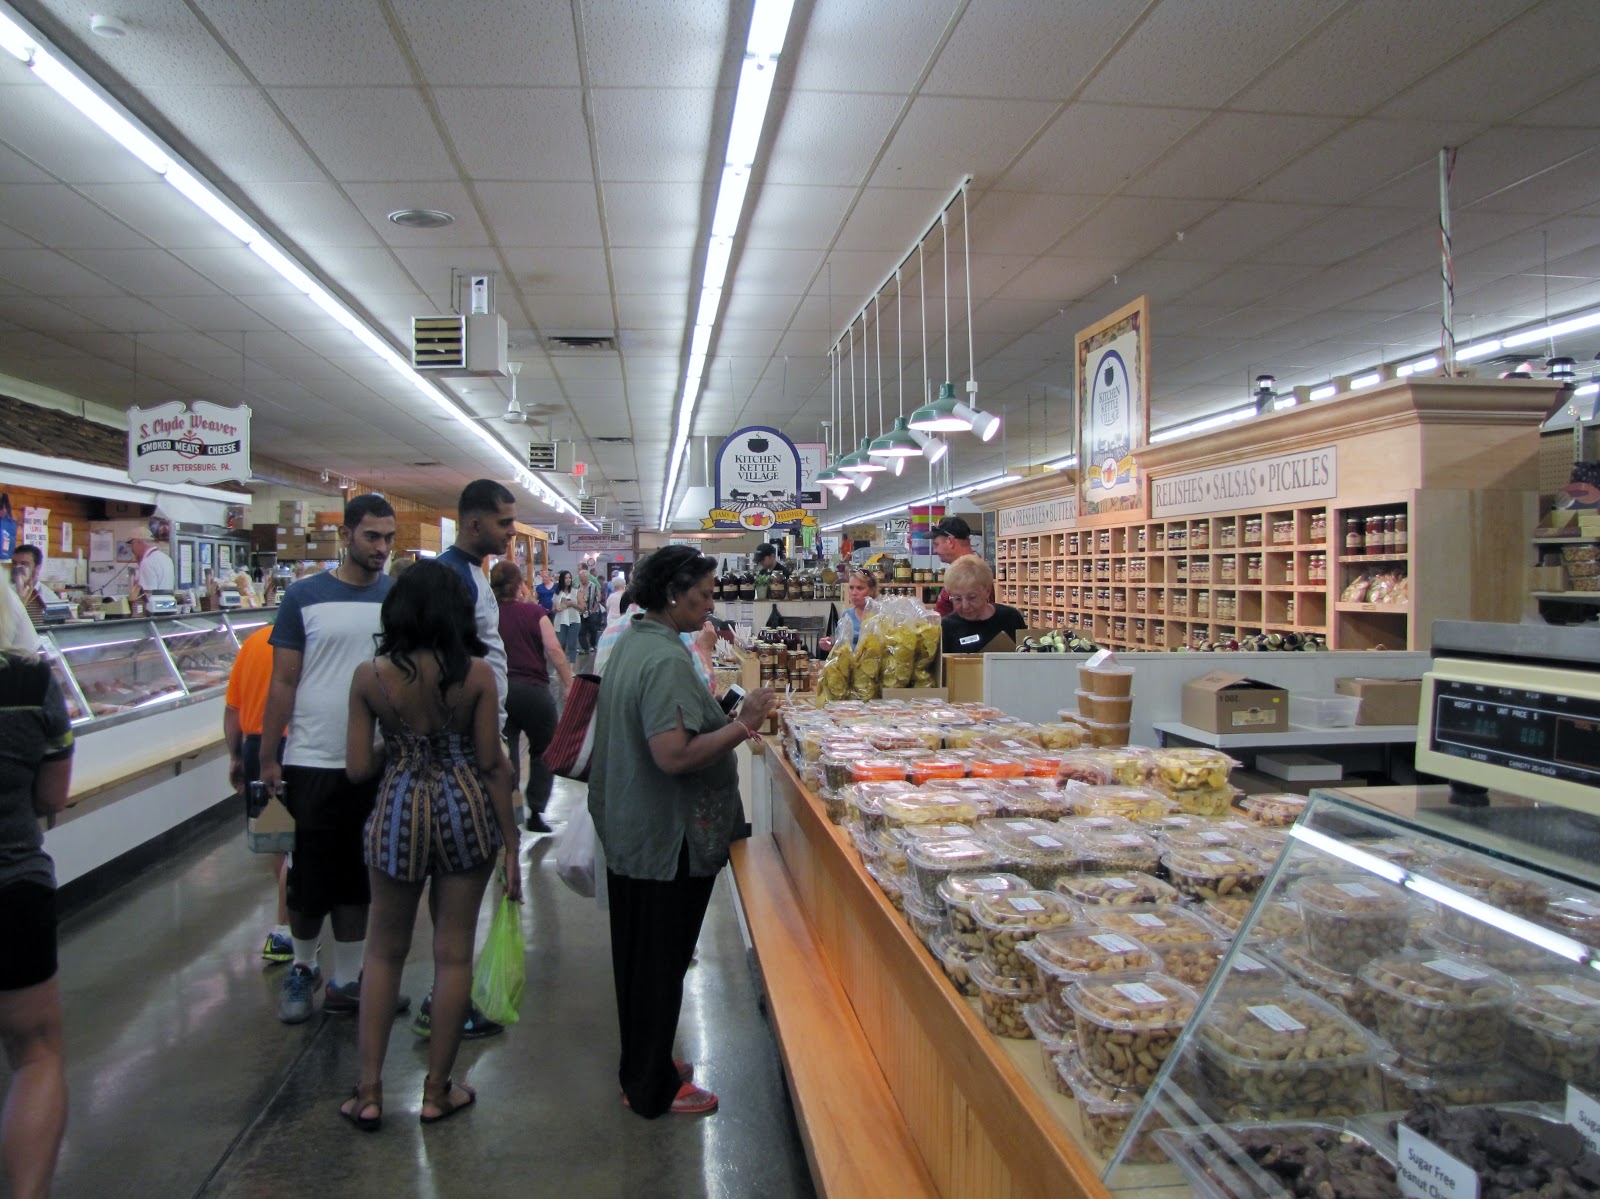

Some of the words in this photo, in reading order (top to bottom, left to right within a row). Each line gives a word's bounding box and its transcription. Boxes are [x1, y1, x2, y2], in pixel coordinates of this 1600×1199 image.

[1099, 385, 1121, 404] KITCHEN
[1101, 398, 1119, 413] KETTLE
[1101, 409, 1119, 424] VILLAGE
[153, 416, 185, 436] Clyde
[190, 415, 237, 436] Weaver
[142, 441, 172, 454] SMOKED
[175, 442, 200, 454] MEATS
[208, 443, 237, 455] CHEESE
[735, 455, 781, 464] KITCHEN
[150, 464, 169, 472] EAST
[738, 472, 780, 480] VILLAGE
[1156, 477, 1203, 507] RELISHES
[1213, 467, 1256, 500] SALSAS
[1268, 454, 1328, 492] PICKLES
[715, 510, 730, 518] JAMS
[777, 509, 803, 519] RELISHES
[1000, 511, 1012, 534] JAMS
[1016, 505, 1045, 527] PRESERVES
[1454, 701, 1471, 709] WEIGHT
[1512, 710, 1527, 719] PRICE
[1509, 760, 1530, 769] CAPACITY
[1398, 1161, 1427, 1192] Peanut
[1408, 1148, 1432, 1173] Sugar
[1435, 1166, 1456, 1190] Free
